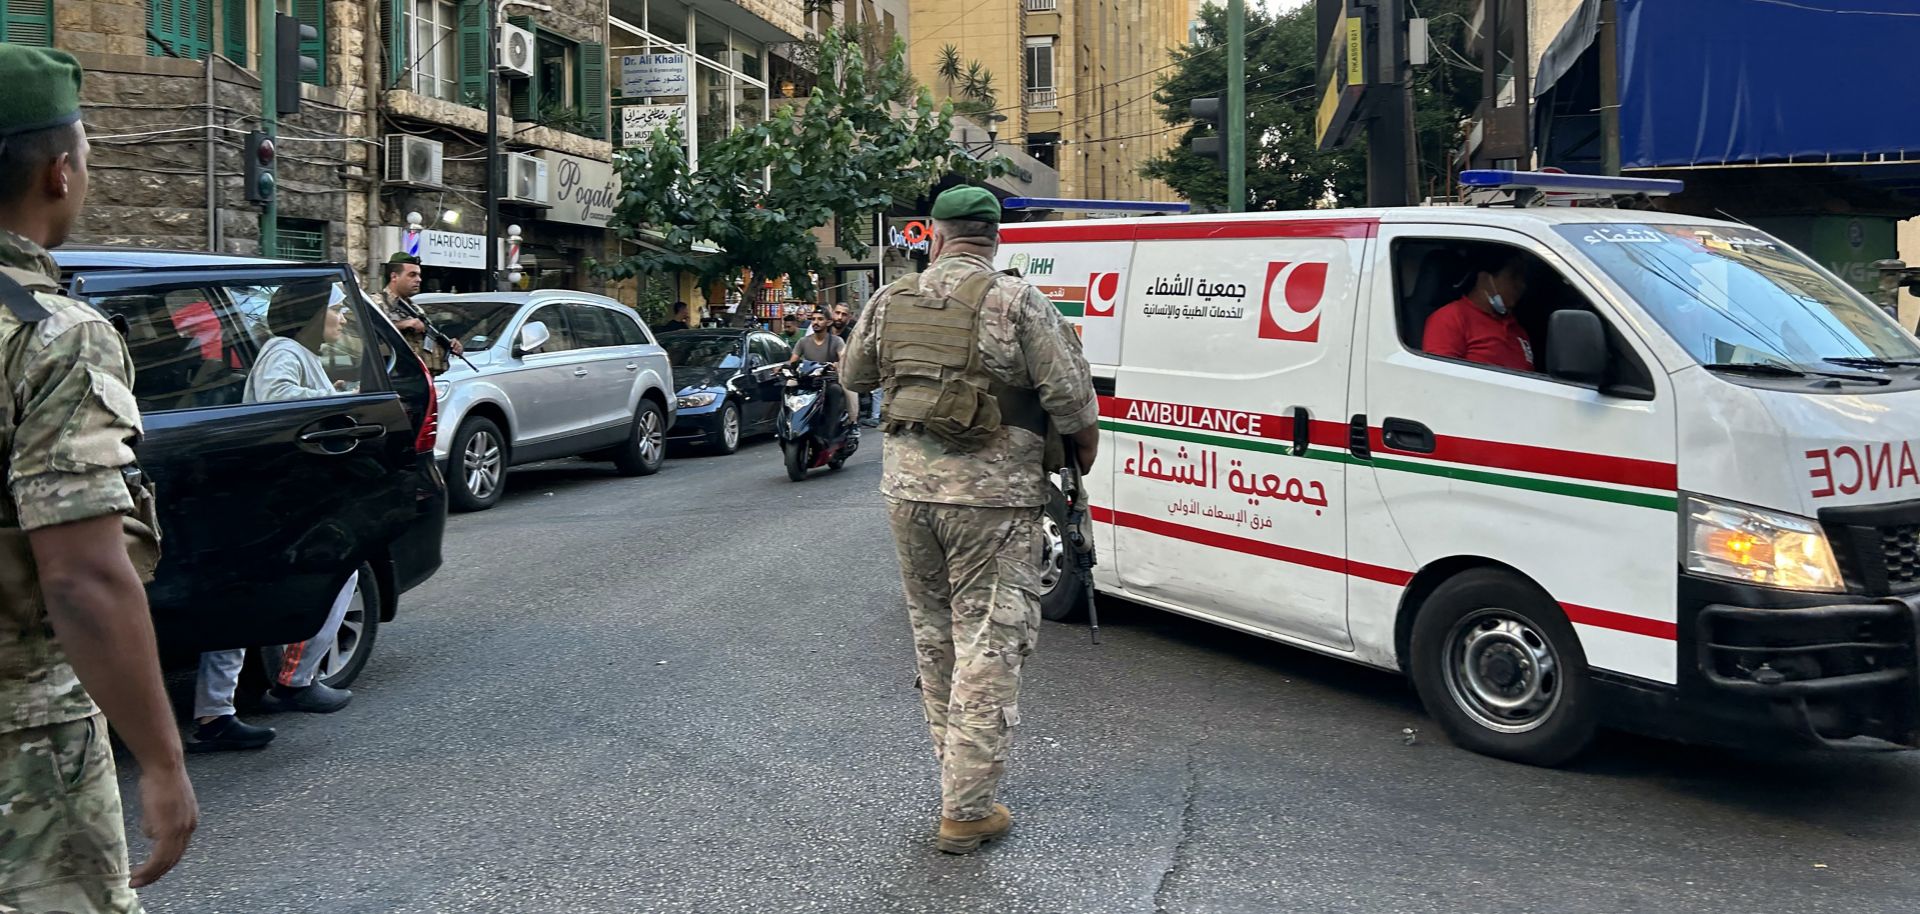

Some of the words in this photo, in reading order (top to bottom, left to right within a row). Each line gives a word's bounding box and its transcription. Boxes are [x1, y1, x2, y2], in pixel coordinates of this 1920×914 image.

[624, 56, 637, 66] Dr.
[639, 56, 652, 65] Ali
[655, 55, 683, 64] Khalil
[1583, 228, 1670, 246] الشفاء
[1146, 273, 1194, 297] الشفاء
[1196, 279, 1247, 303] جمعية
[1182, 305, 1208, 319] الطبية
[1209, 306, 1244, 319] للخدمات
[1126, 401, 1262, 436] AMBULANCE
[1124, 441, 1218, 490] الشفاء
[1228, 459, 1329, 517] جمعية
[1202, 504, 1247, 529] الإسعاف
[1250, 511, 1273, 530] فرق
